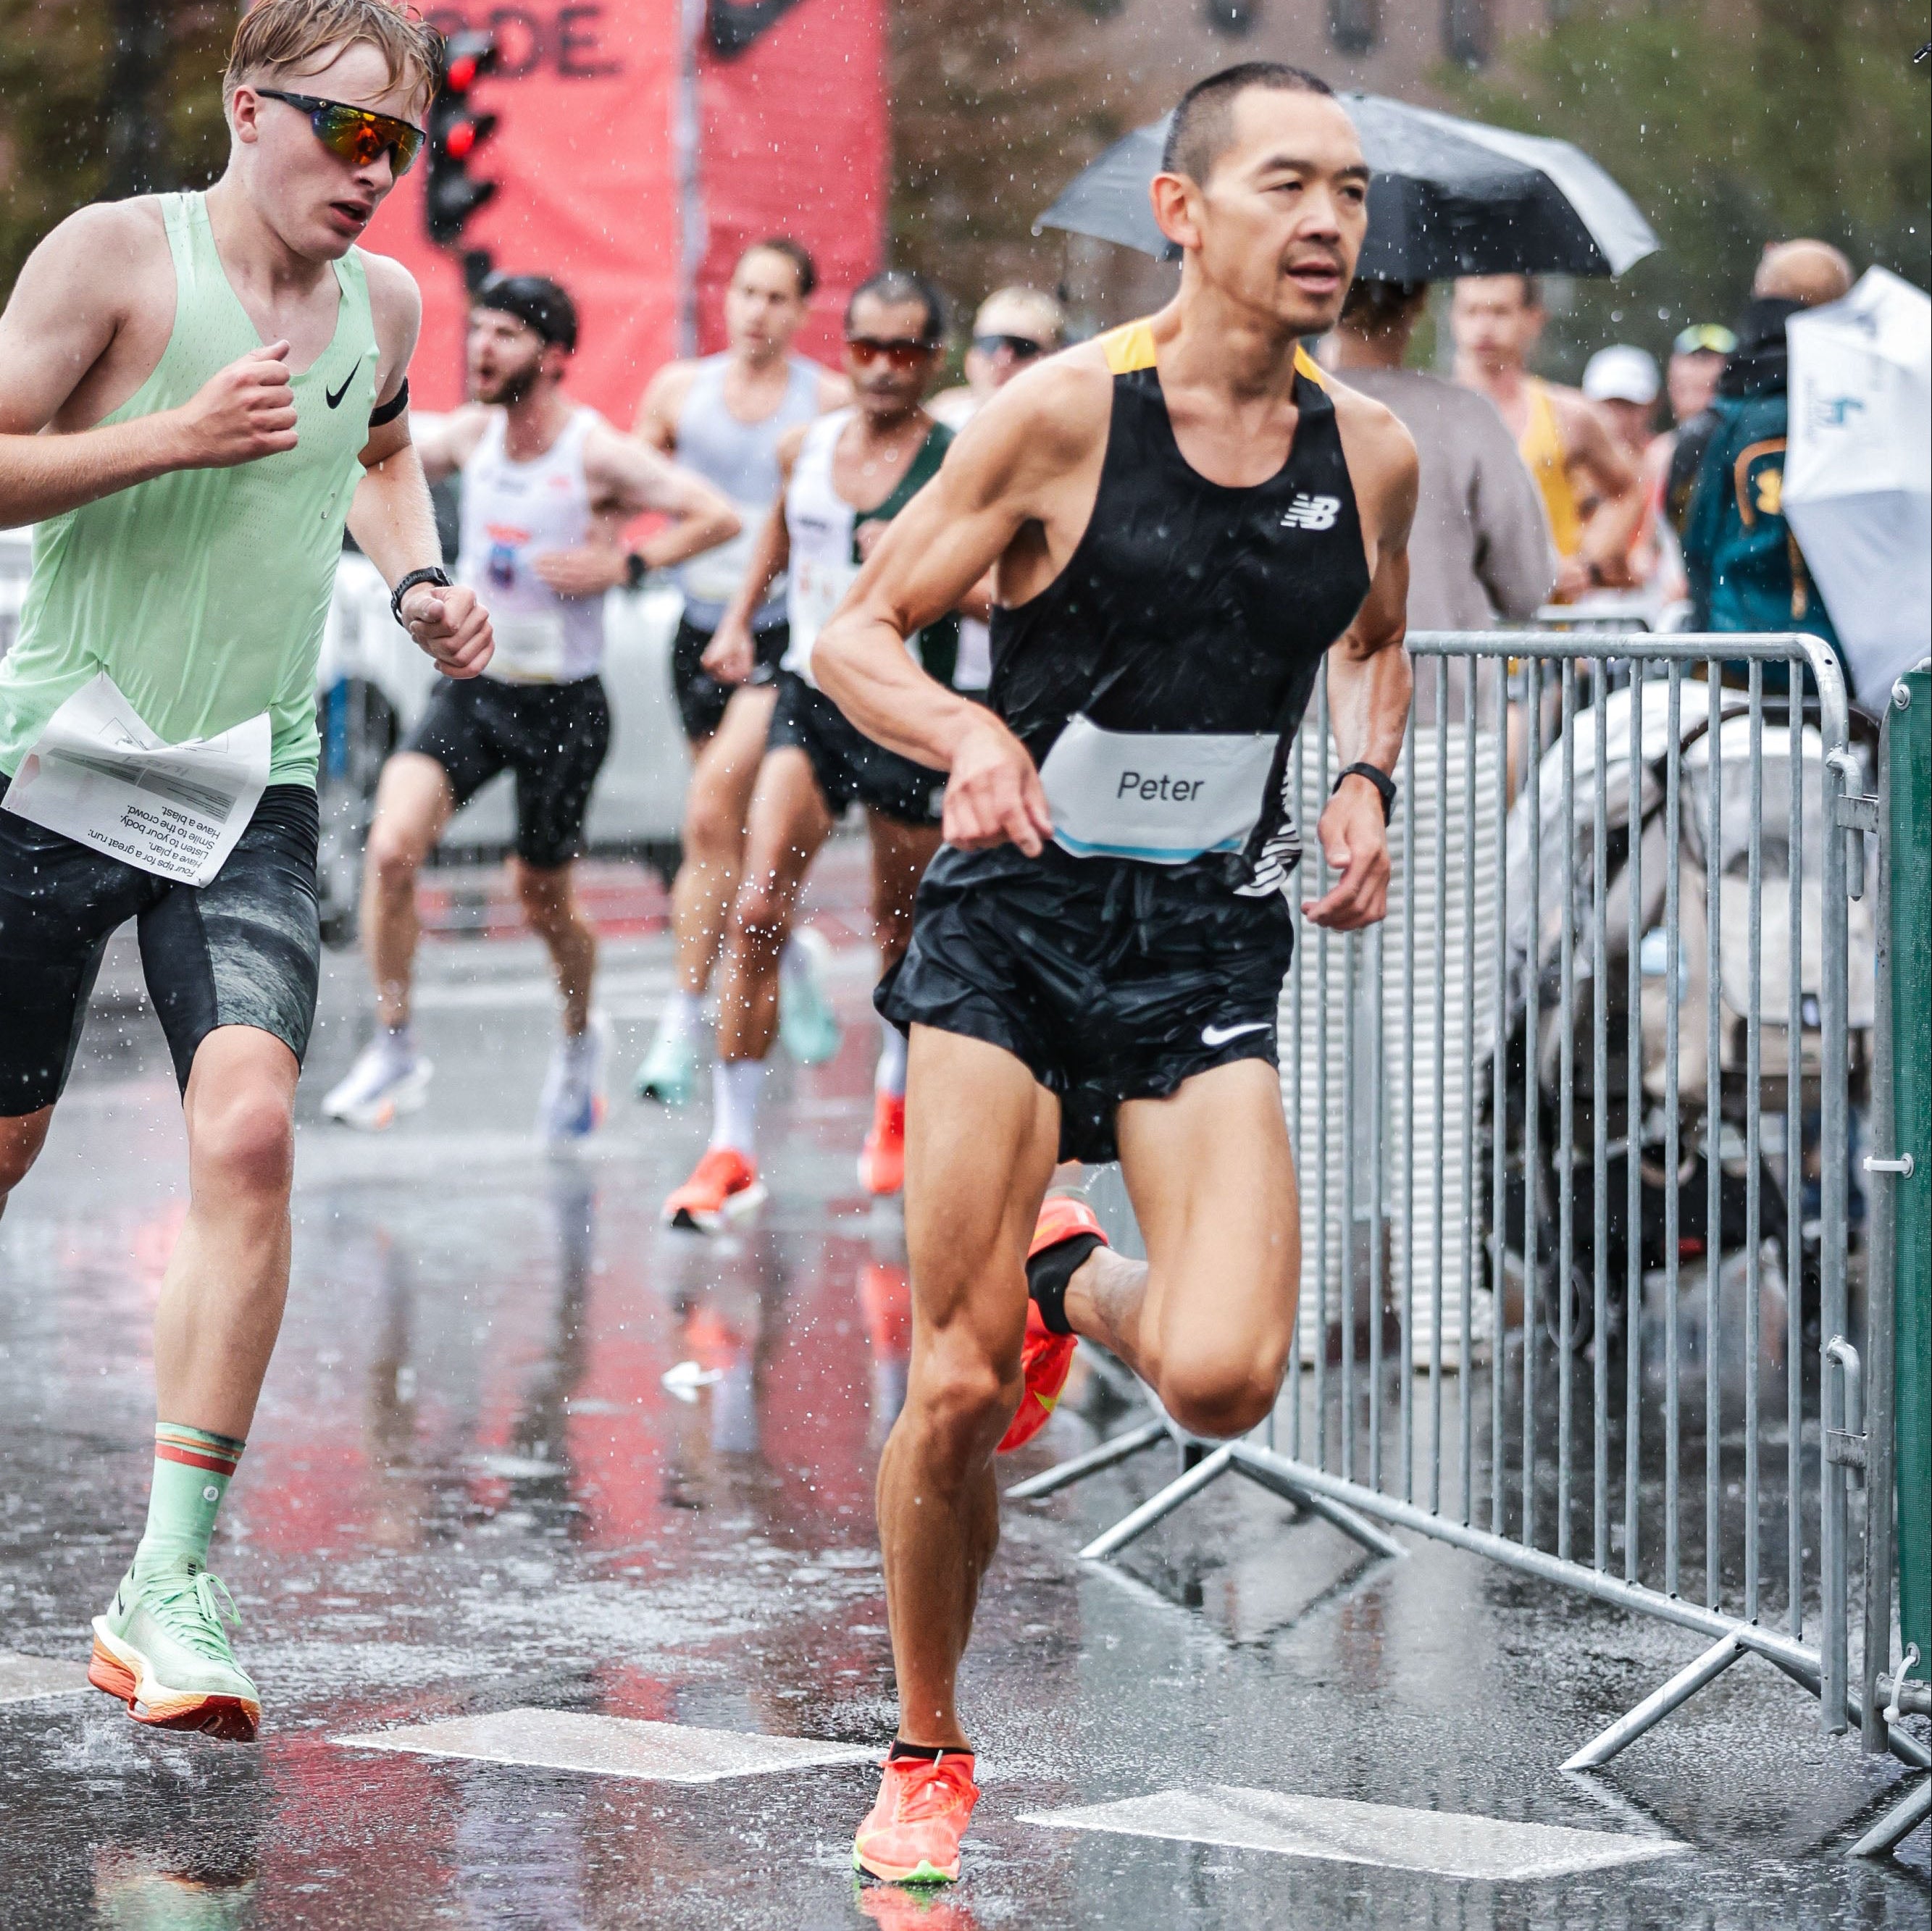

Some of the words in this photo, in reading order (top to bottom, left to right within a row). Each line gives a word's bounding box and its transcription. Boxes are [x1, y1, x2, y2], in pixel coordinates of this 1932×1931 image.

[1116, 771, 1205, 801] Peter
[127, 805, 159, 824] crowd.
[162, 806, 188, 822] blast.
[120, 815, 146, 832] body.
[160, 819, 177, 833] the
[196, 822, 221, 839] Have
[88, 829, 108, 842] run:
[146, 828, 169, 843] your
[169, 838, 180, 848] to
[188, 833, 215, 850] Smile
[109, 839, 135, 855] great
[149, 842, 172, 857] plan.
[180, 844, 209, 860] Listen
[143, 854, 156, 866] for
[157, 858, 175, 871] tips
[180, 857, 203, 868] Have
[175, 866, 196, 877] Four
